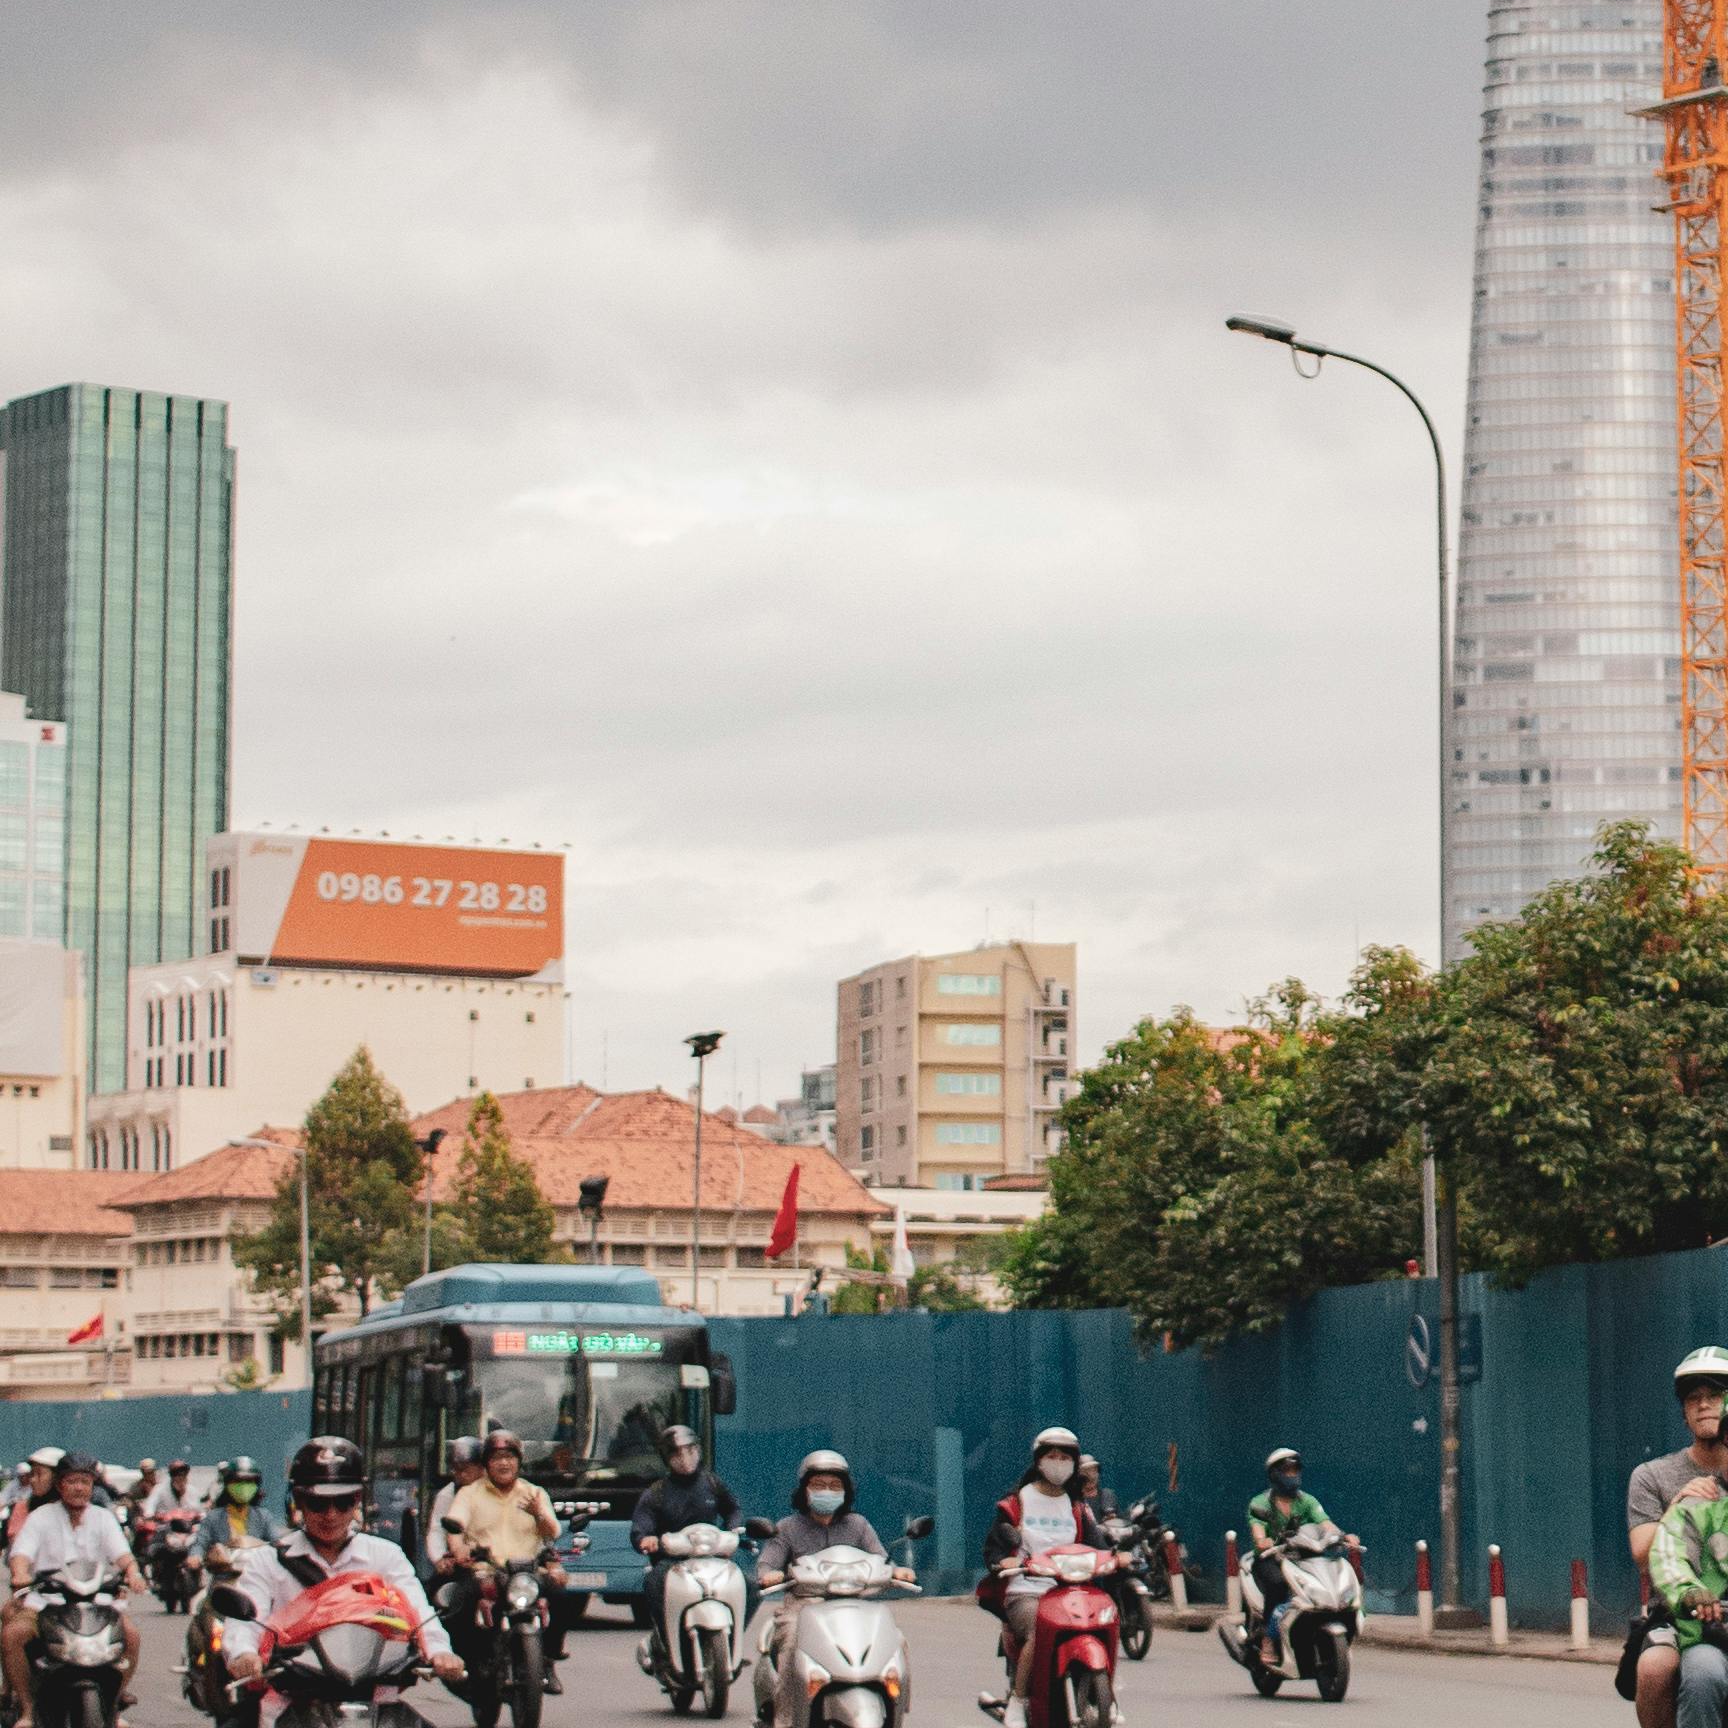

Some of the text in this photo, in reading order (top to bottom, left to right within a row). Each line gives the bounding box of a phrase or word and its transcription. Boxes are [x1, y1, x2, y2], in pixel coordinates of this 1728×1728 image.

[317, 871, 547, 913] 0986 27 28 28
